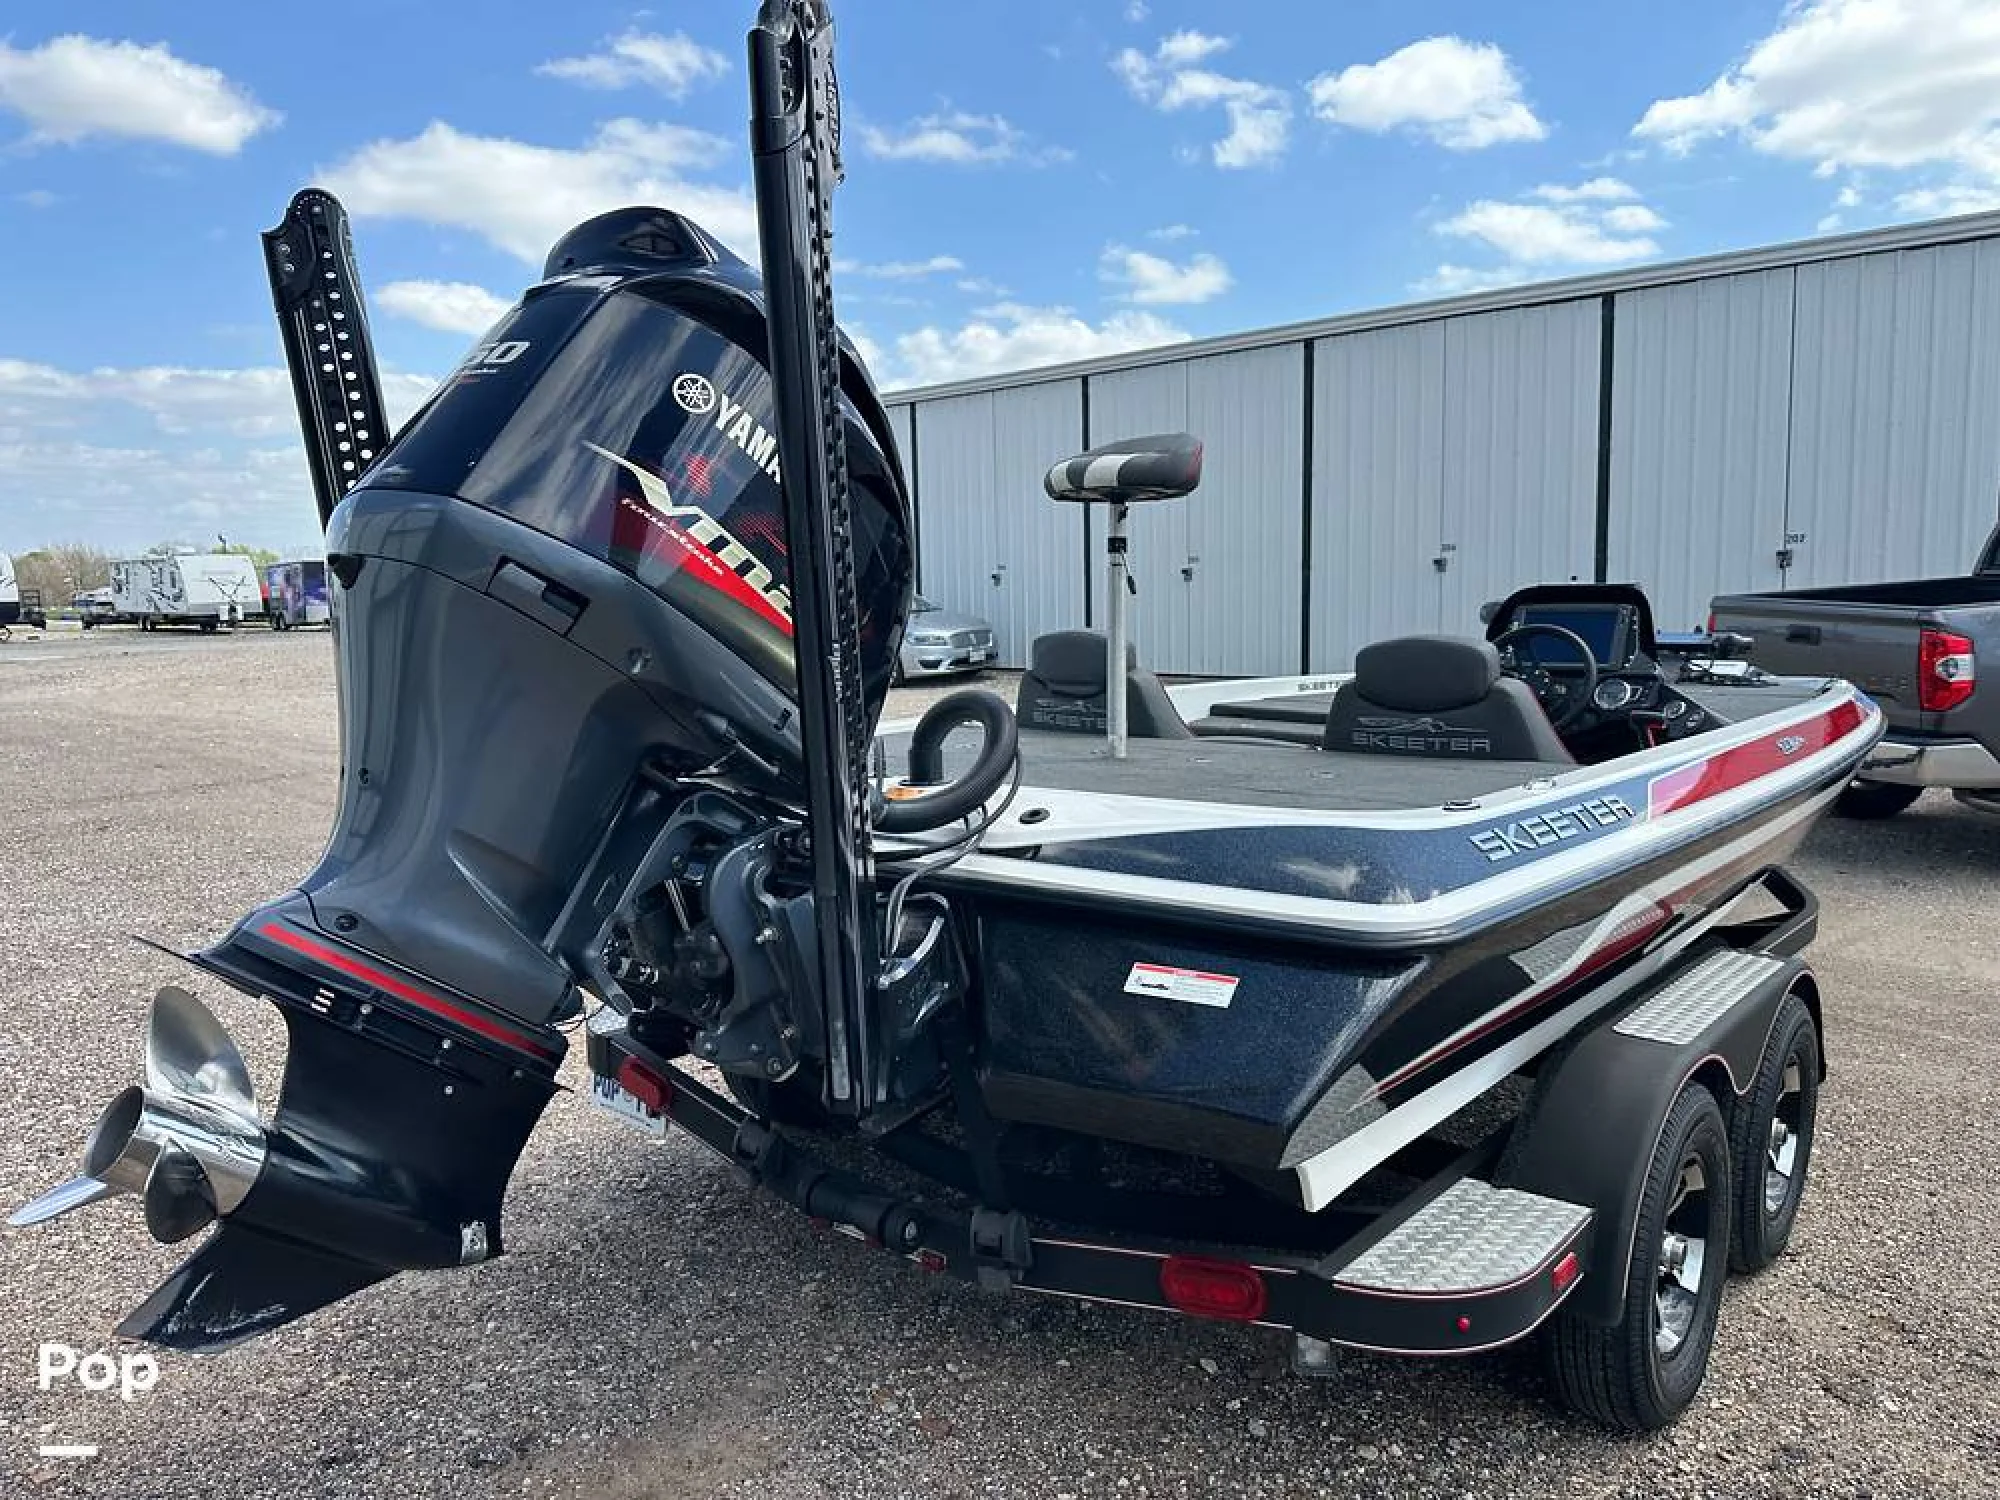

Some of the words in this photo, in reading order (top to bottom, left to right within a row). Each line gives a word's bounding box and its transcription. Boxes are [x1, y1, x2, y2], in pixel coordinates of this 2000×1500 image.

[715, 393, 781, 485] YAMA
[1033, 711, 1109, 729] SKEETE
[1351, 730, 1491, 753] SKEETER
[1468, 794, 1637, 863] SKEETER
